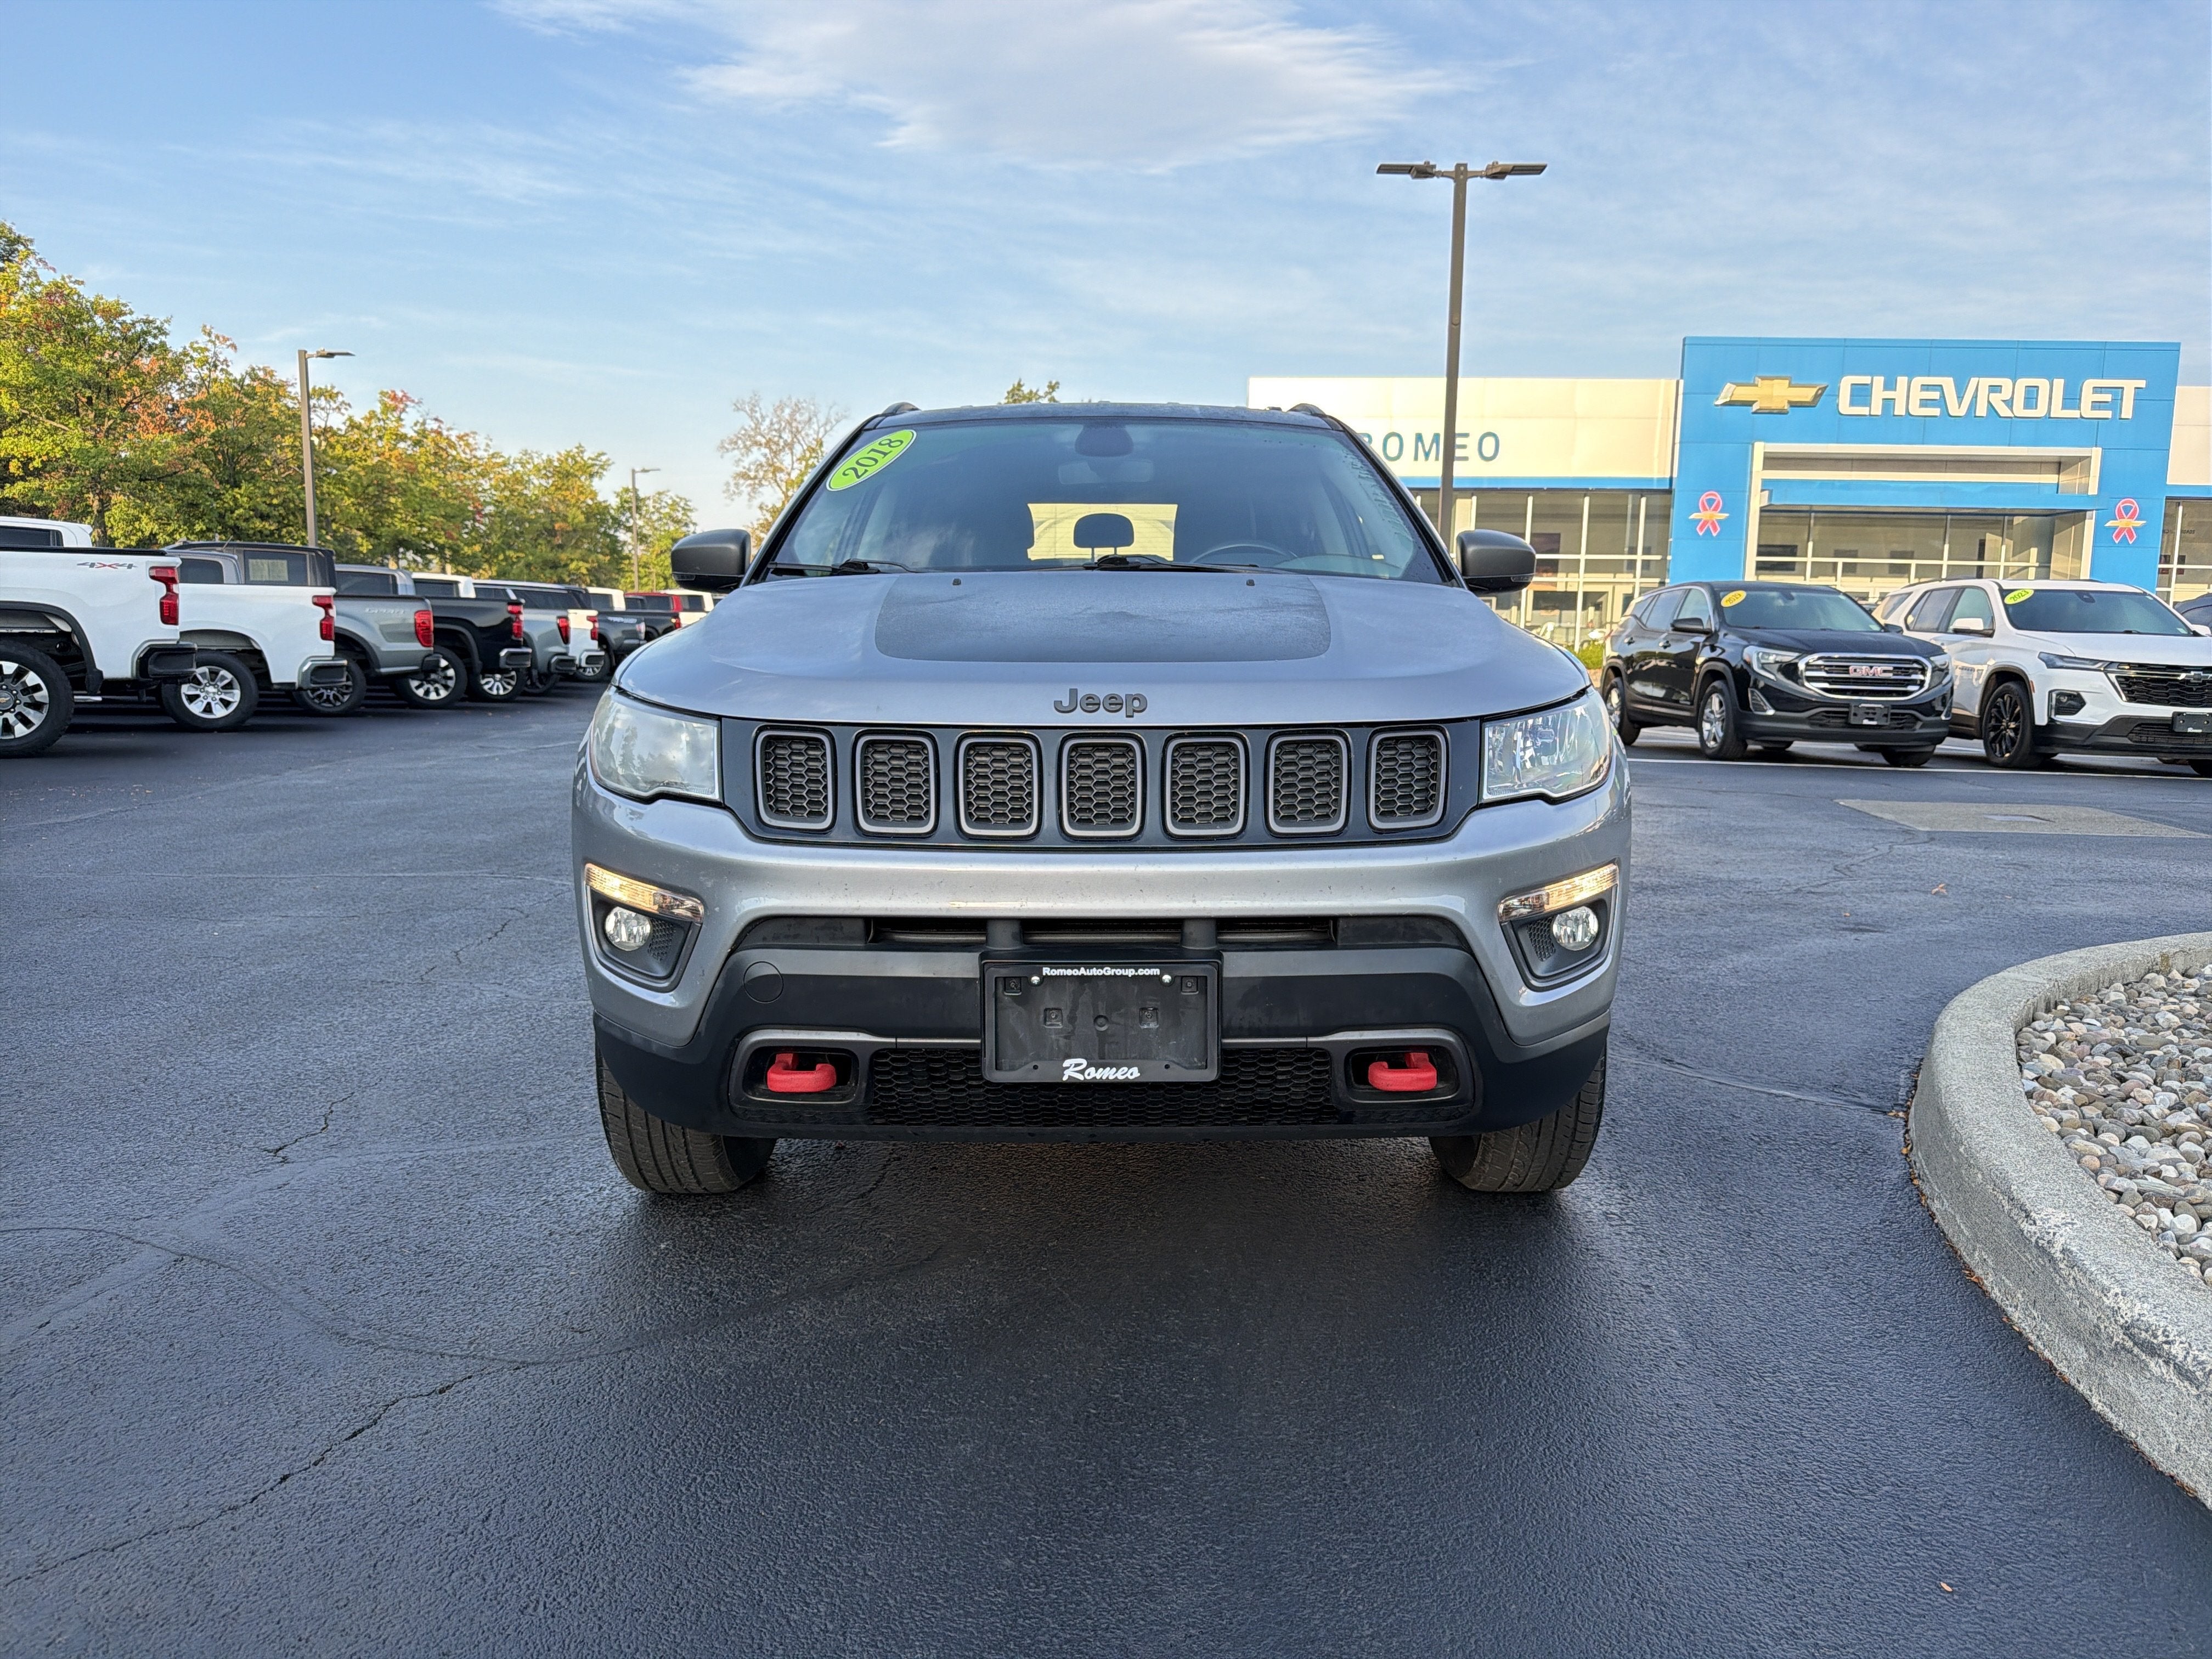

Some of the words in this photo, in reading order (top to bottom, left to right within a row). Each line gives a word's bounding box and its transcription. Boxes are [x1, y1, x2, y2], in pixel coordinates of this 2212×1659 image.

[1837, 375, 2146, 419] CHEVROLET
[842, 438, 904, 479] 2018
[2009, 590, 2029, 602] 2023
[1849, 665, 1894, 677] GMC
[1053, 688, 1148, 718] Jeep
[1042, 967, 1160, 978] RomeoAutoGroup.com
[1062, 1058, 1141, 1081] Romeo
